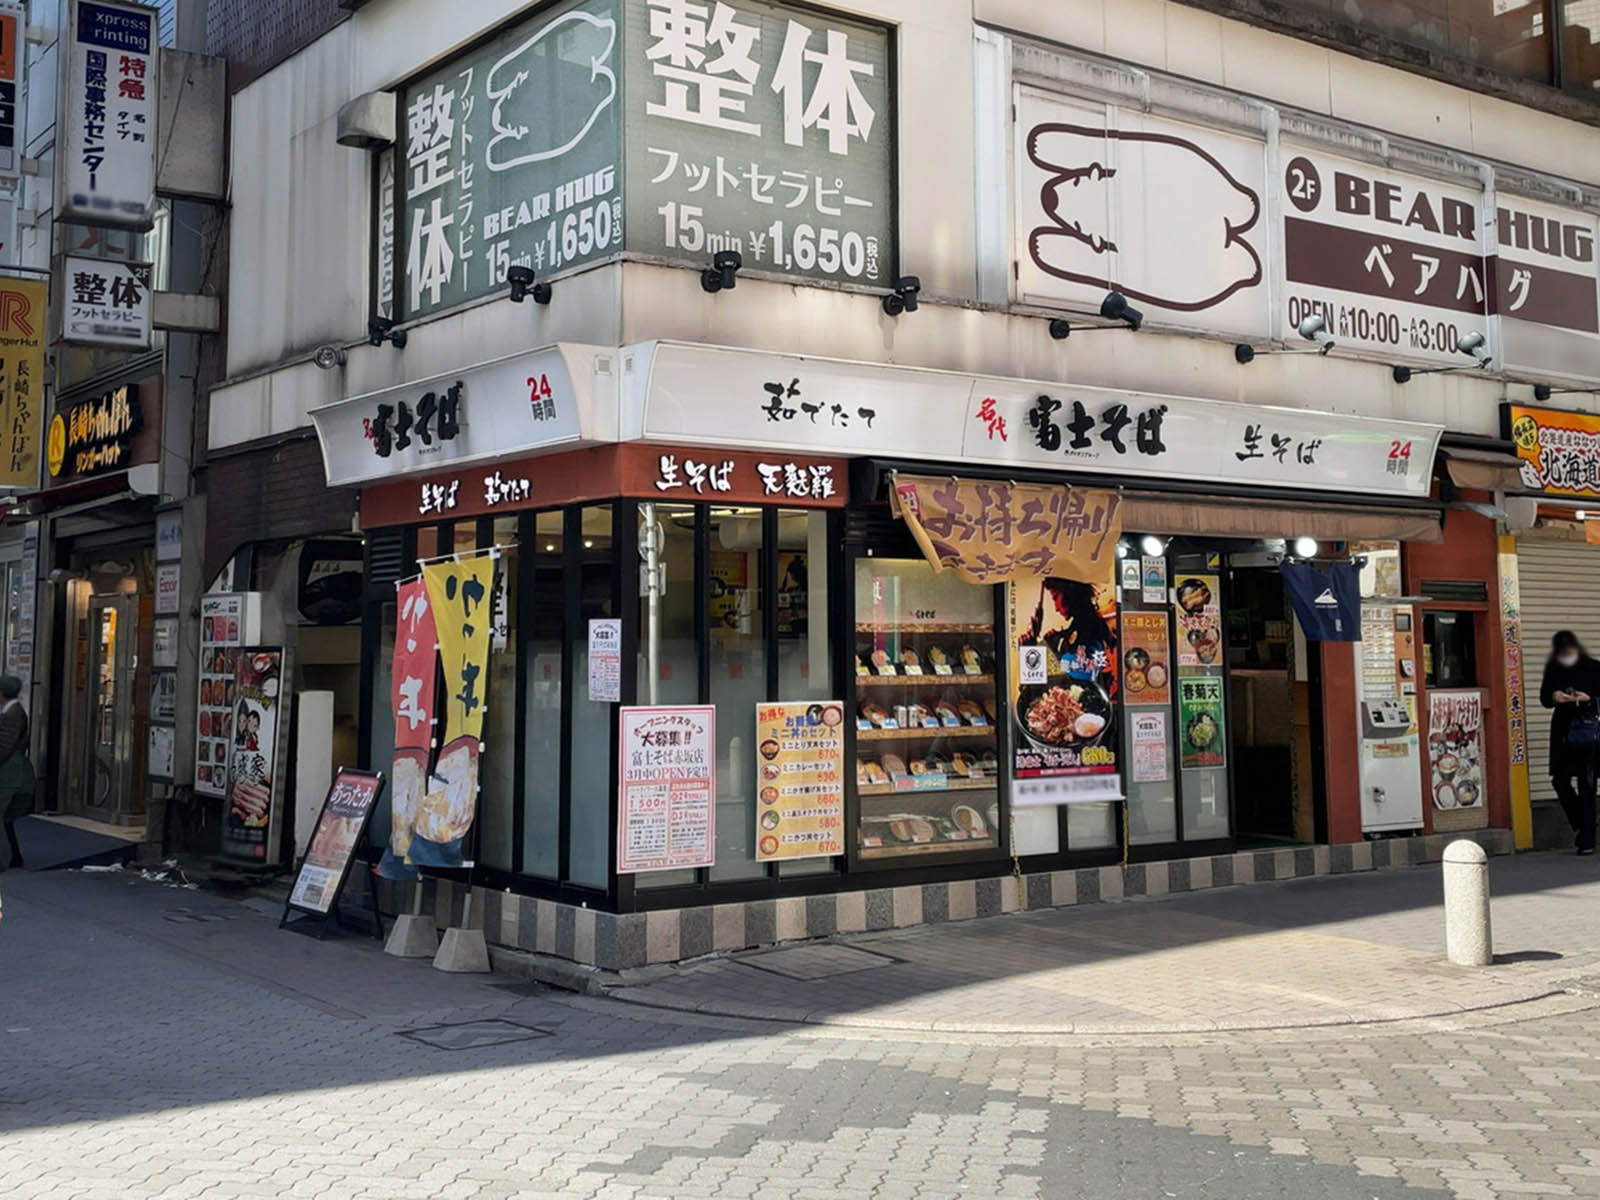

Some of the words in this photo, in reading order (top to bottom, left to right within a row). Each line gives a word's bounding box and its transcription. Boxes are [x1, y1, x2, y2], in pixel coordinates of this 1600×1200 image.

[118, 55, 147, 101] 特急
[645, 0, 876, 156] 整体
[406, 84, 455, 313] 整体
[457, 67, 475, 292] フットセラピー
[483, 192, 550, 240] BEAR
[555, 165, 615, 213] HUG
[647, 147, 873, 217] フットセラピー
[1290, 168, 1316, 201] 2F
[1334, 171, 1477, 242] BEAR
[1497, 206, 1594, 263] HUG
[72, 271, 143, 310] 整体
[1363, 244, 1533, 311] ベアハグ
[71, 306, 143, 323] フットセラピー
[526, 373, 552, 402] 24
[532, 398, 557, 422] 時間
[761, 378, 876, 430] 茹でたて
[10, 359, 32, 473] 長崎ちゃんぽん
[976, 397, 1008, 443] 名代
[1028, 396, 1168, 456] 富士そば
[1234, 424, 1323, 466] 生そば
[1388, 440, 1412, 460] 24
[656, 455, 736, 493] 生そば
[1541, 448, 1600, 489] 北海道
[418, 479, 460, 516] 生そば
[1183, 683, 1220, 700] 春菊天
